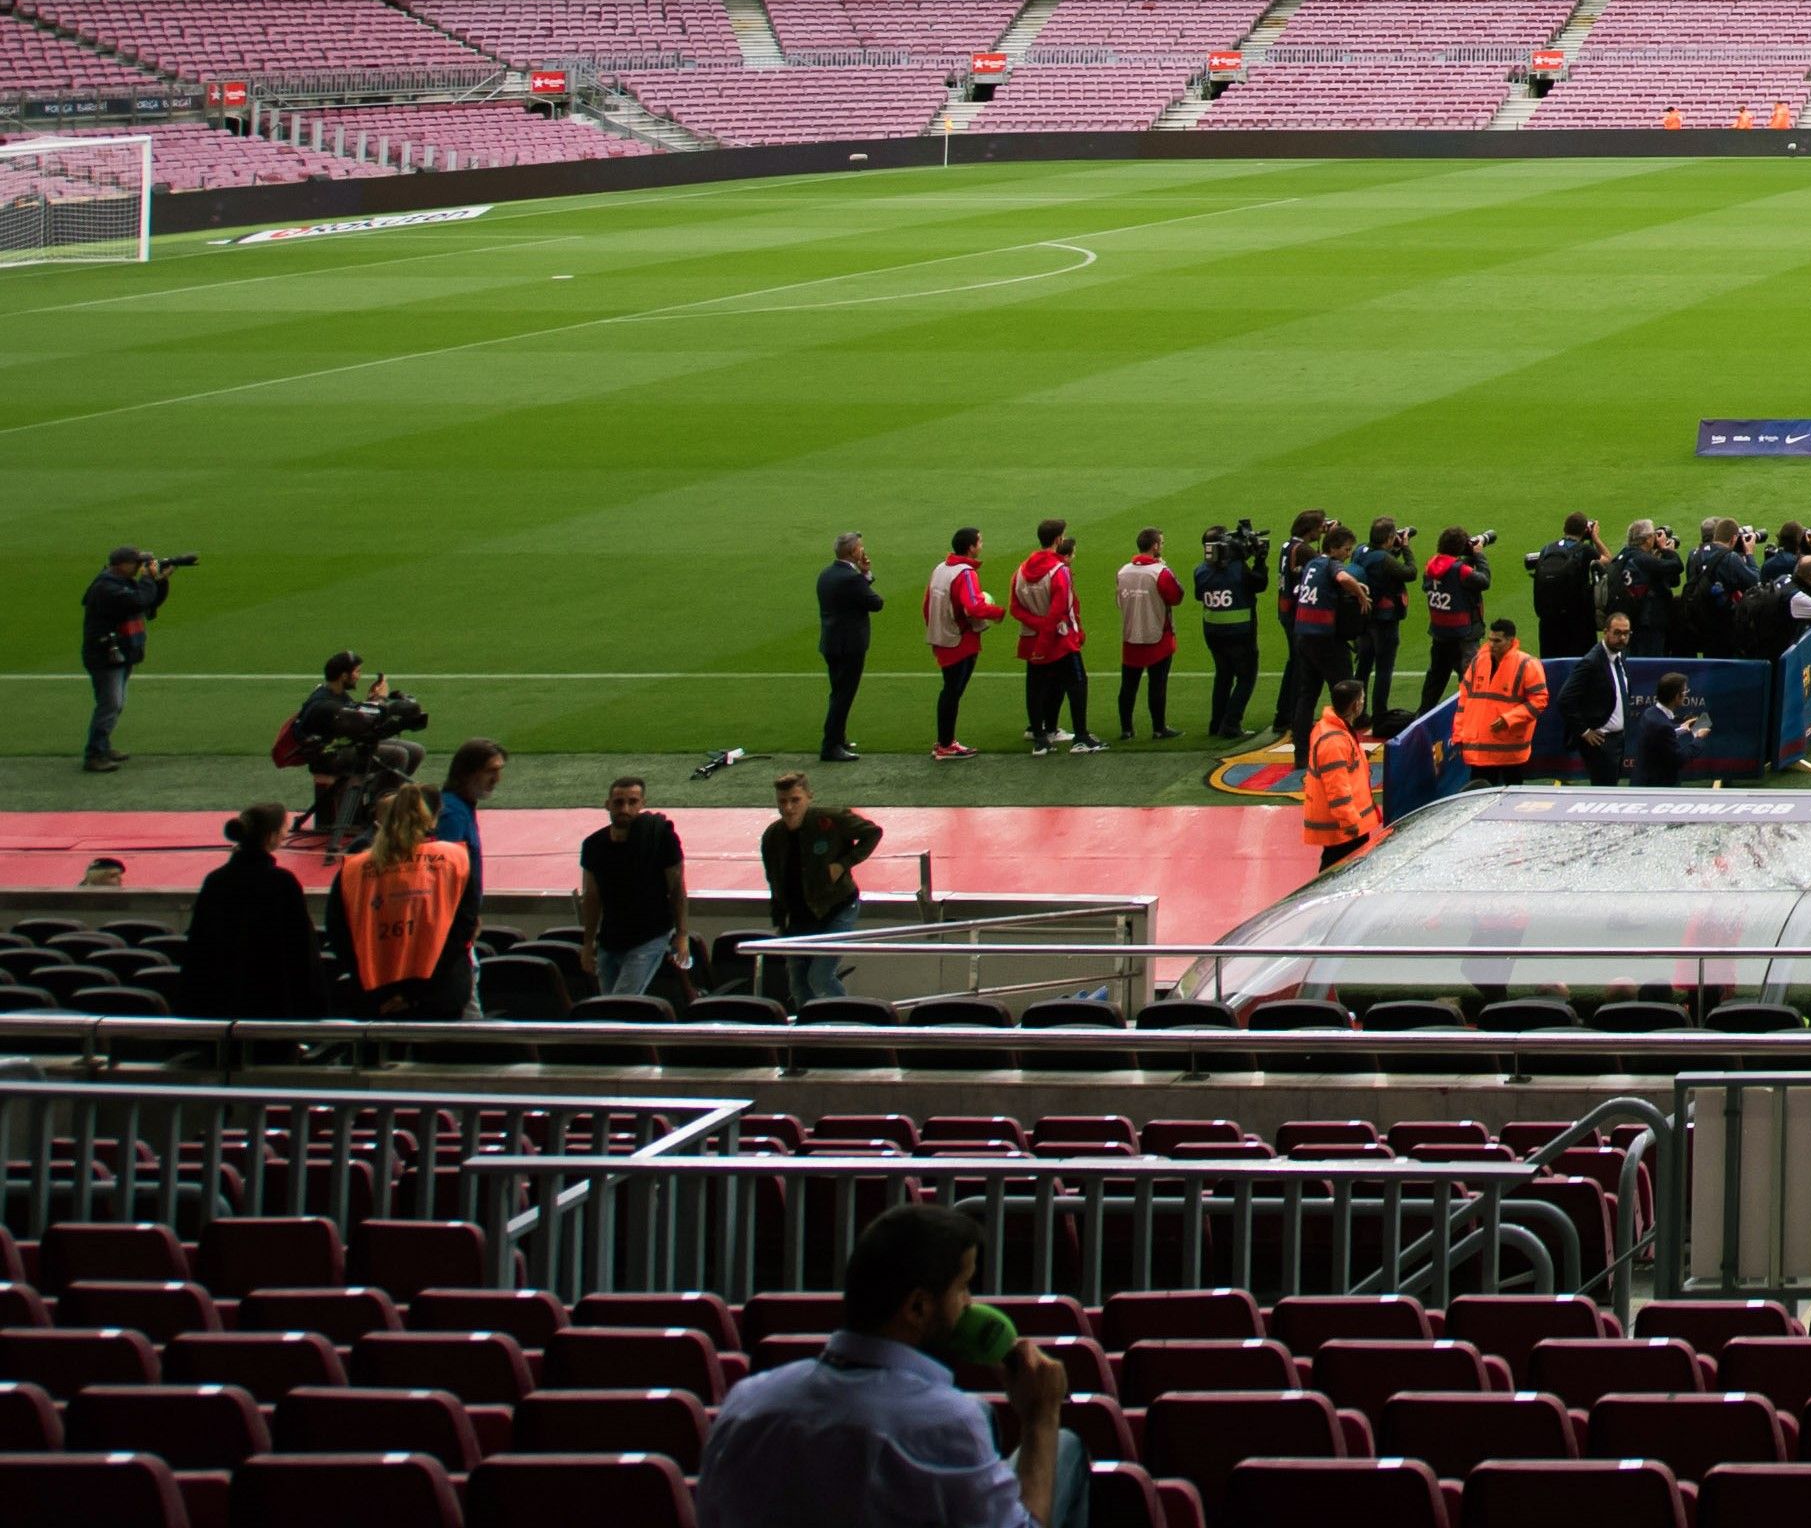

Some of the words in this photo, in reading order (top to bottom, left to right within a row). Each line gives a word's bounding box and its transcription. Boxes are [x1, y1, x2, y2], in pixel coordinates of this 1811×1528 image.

[1302, 567, 1316, 585] F
[1203, 589, 1233, 608] 056
[1567, 801, 1797, 817] NIKE.COM/FCB
